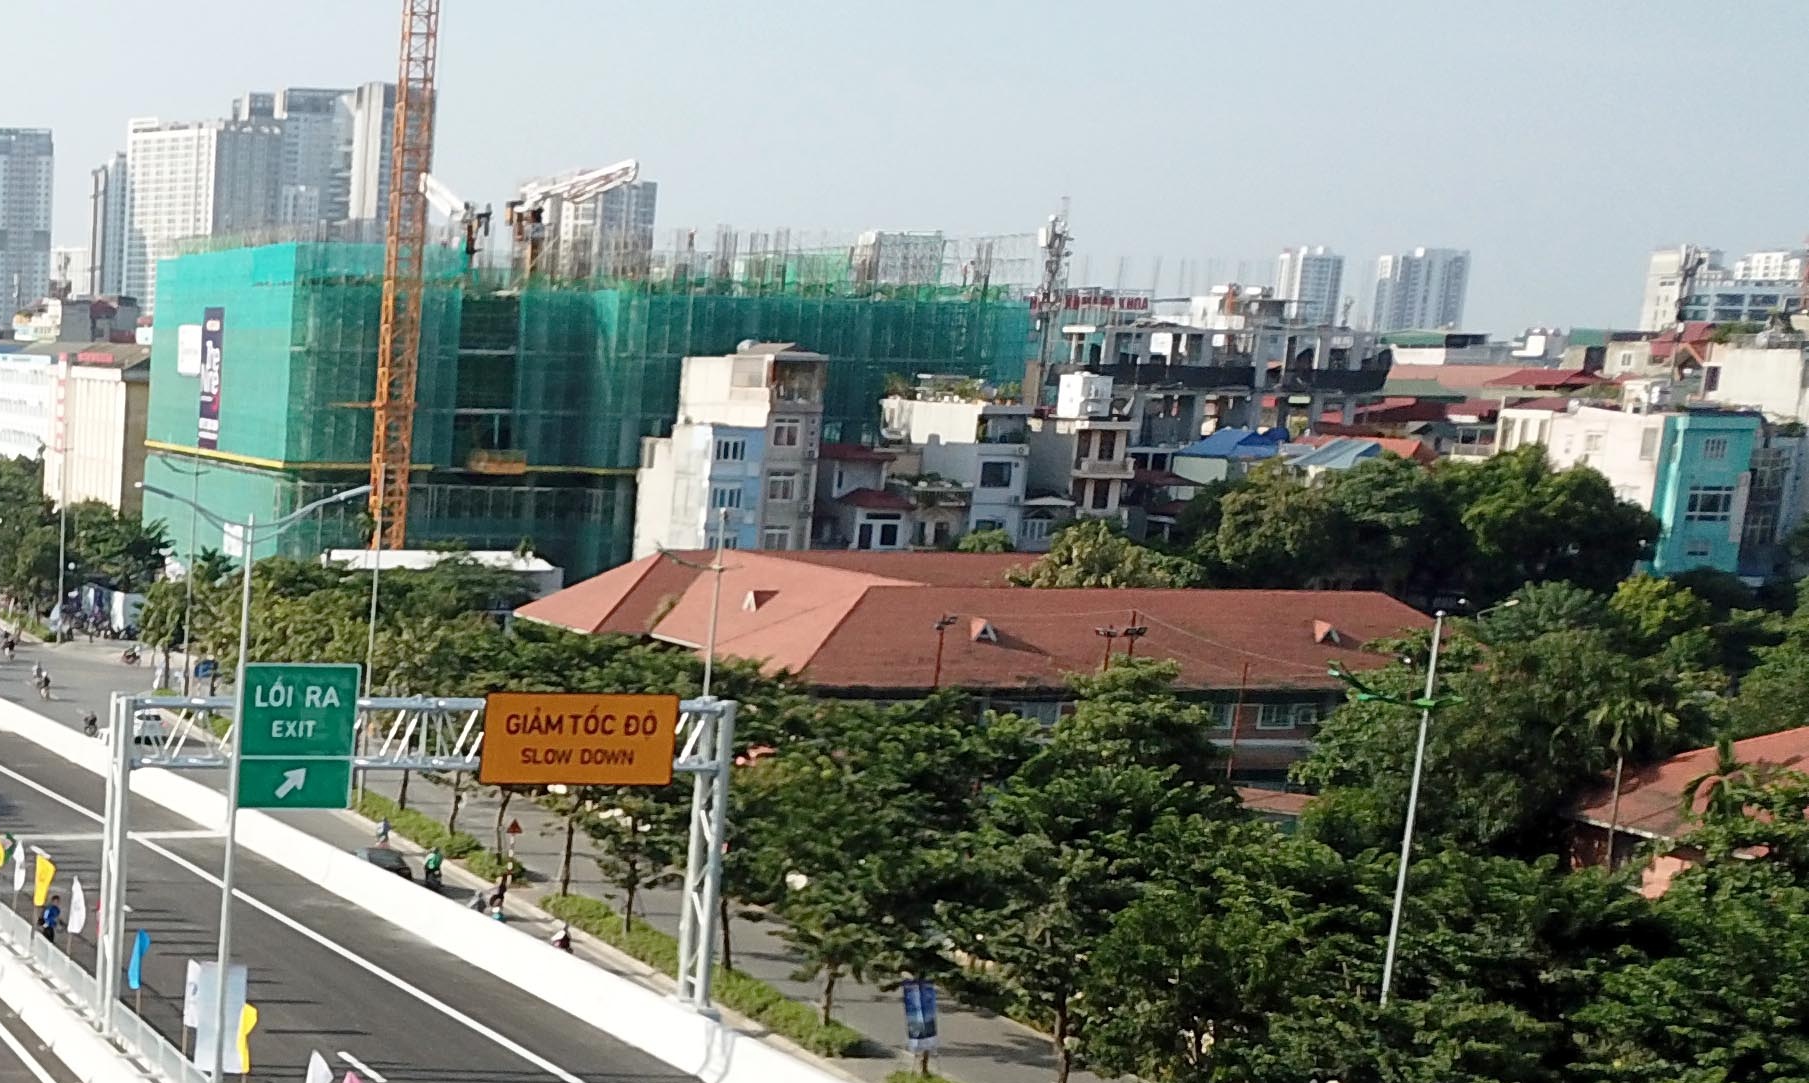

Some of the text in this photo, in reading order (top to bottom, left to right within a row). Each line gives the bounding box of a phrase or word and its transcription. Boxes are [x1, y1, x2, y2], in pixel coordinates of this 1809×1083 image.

[254, 676, 340, 708] LỐI RA
[272, 720, 317, 738] EXIT
[505, 704, 658, 741] GIẢM TỐC ĐỘ
[520, 747, 635, 765] SLOW DOWN
